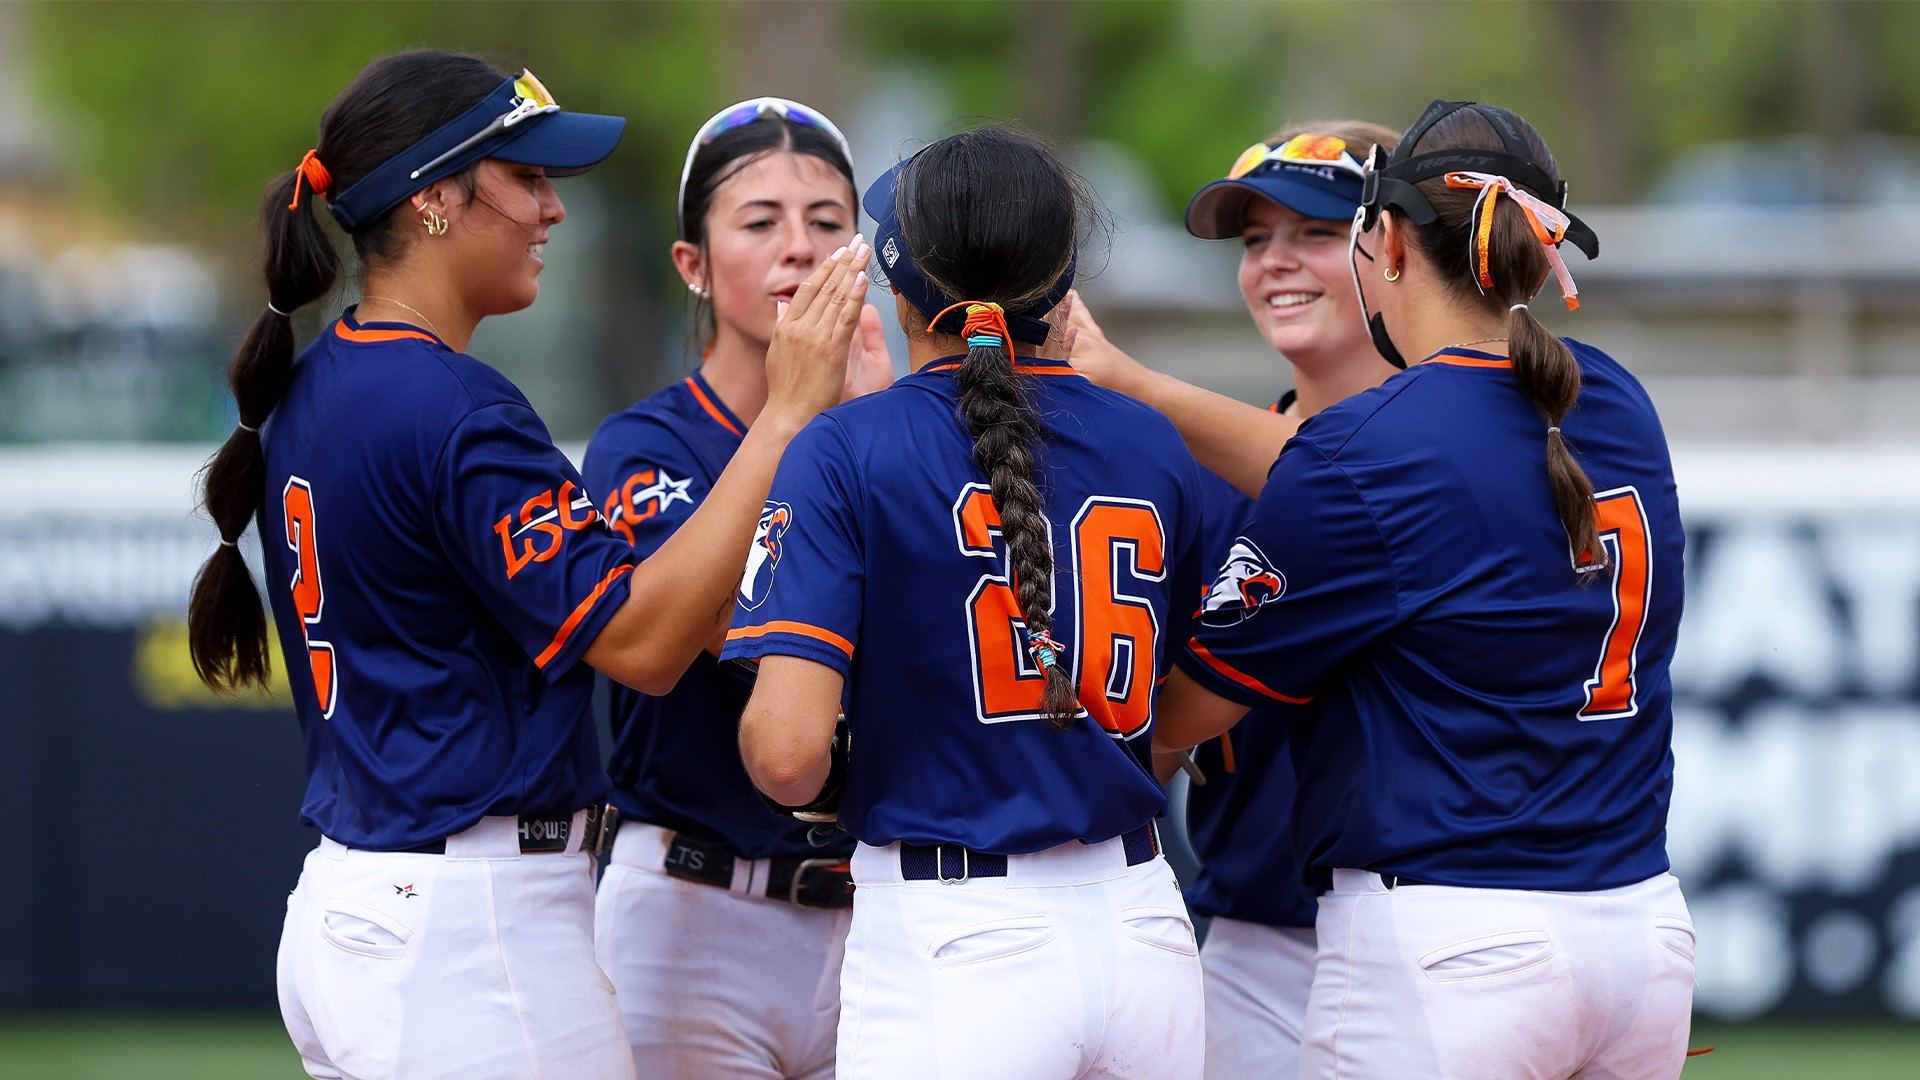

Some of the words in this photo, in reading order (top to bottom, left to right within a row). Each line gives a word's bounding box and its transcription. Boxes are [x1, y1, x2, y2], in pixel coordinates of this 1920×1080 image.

[1415, 155, 1496, 172] RIP-IT
[283, 475, 338, 720] 2
[494, 480, 596, 580] LSC
[952, 481, 1167, 741] 26
[1571, 485, 1653, 722] 7
